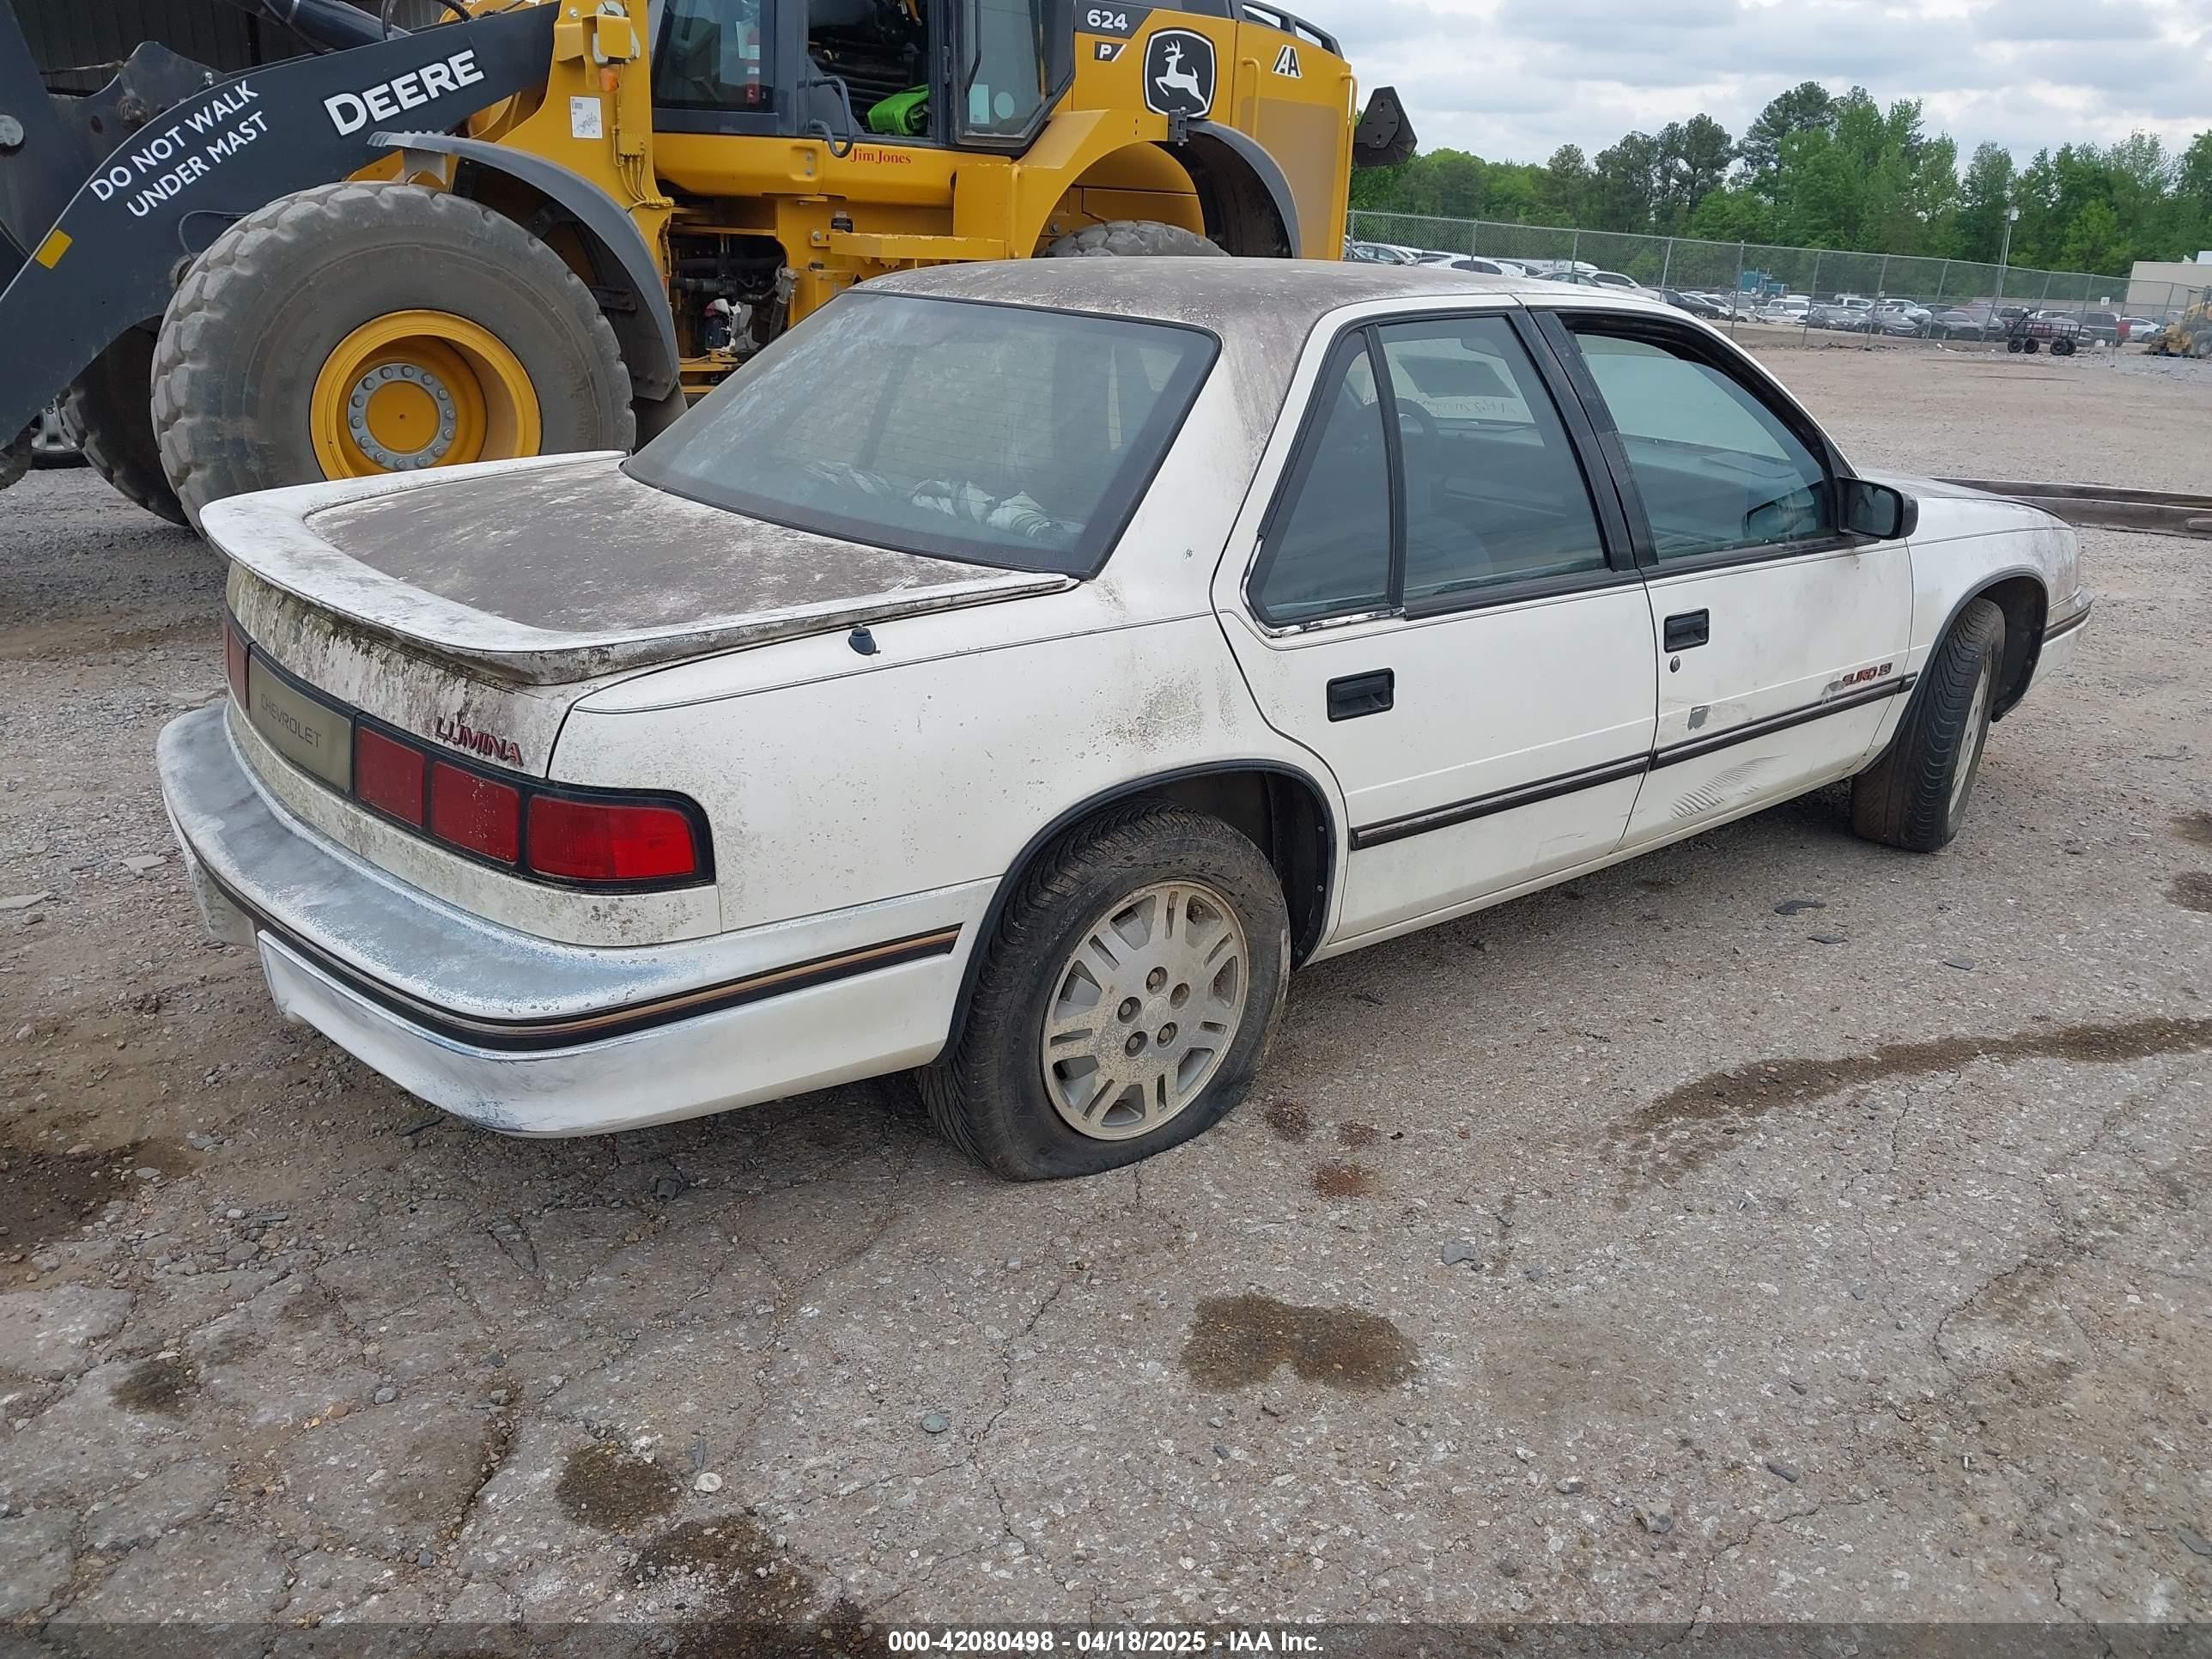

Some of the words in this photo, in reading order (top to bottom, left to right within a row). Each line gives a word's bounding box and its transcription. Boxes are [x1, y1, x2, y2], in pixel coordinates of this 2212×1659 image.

[1087, 9, 1127, 31] 624
[1099, 44, 1112, 59] P
[323, 49, 485, 137] DEERE
[89, 166, 131, 201] DO
[131, 125, 185, 173] NOT
[184, 80, 259, 134] WALK
[126, 155, 210, 216] UNDER
[205, 111, 268, 163] MAST
[851, 148, 874, 163] Jim
[876, 150, 912, 165] Jones
[260, 693, 322, 750] CHEVROLET
[434, 716, 524, 767] LUMINA
